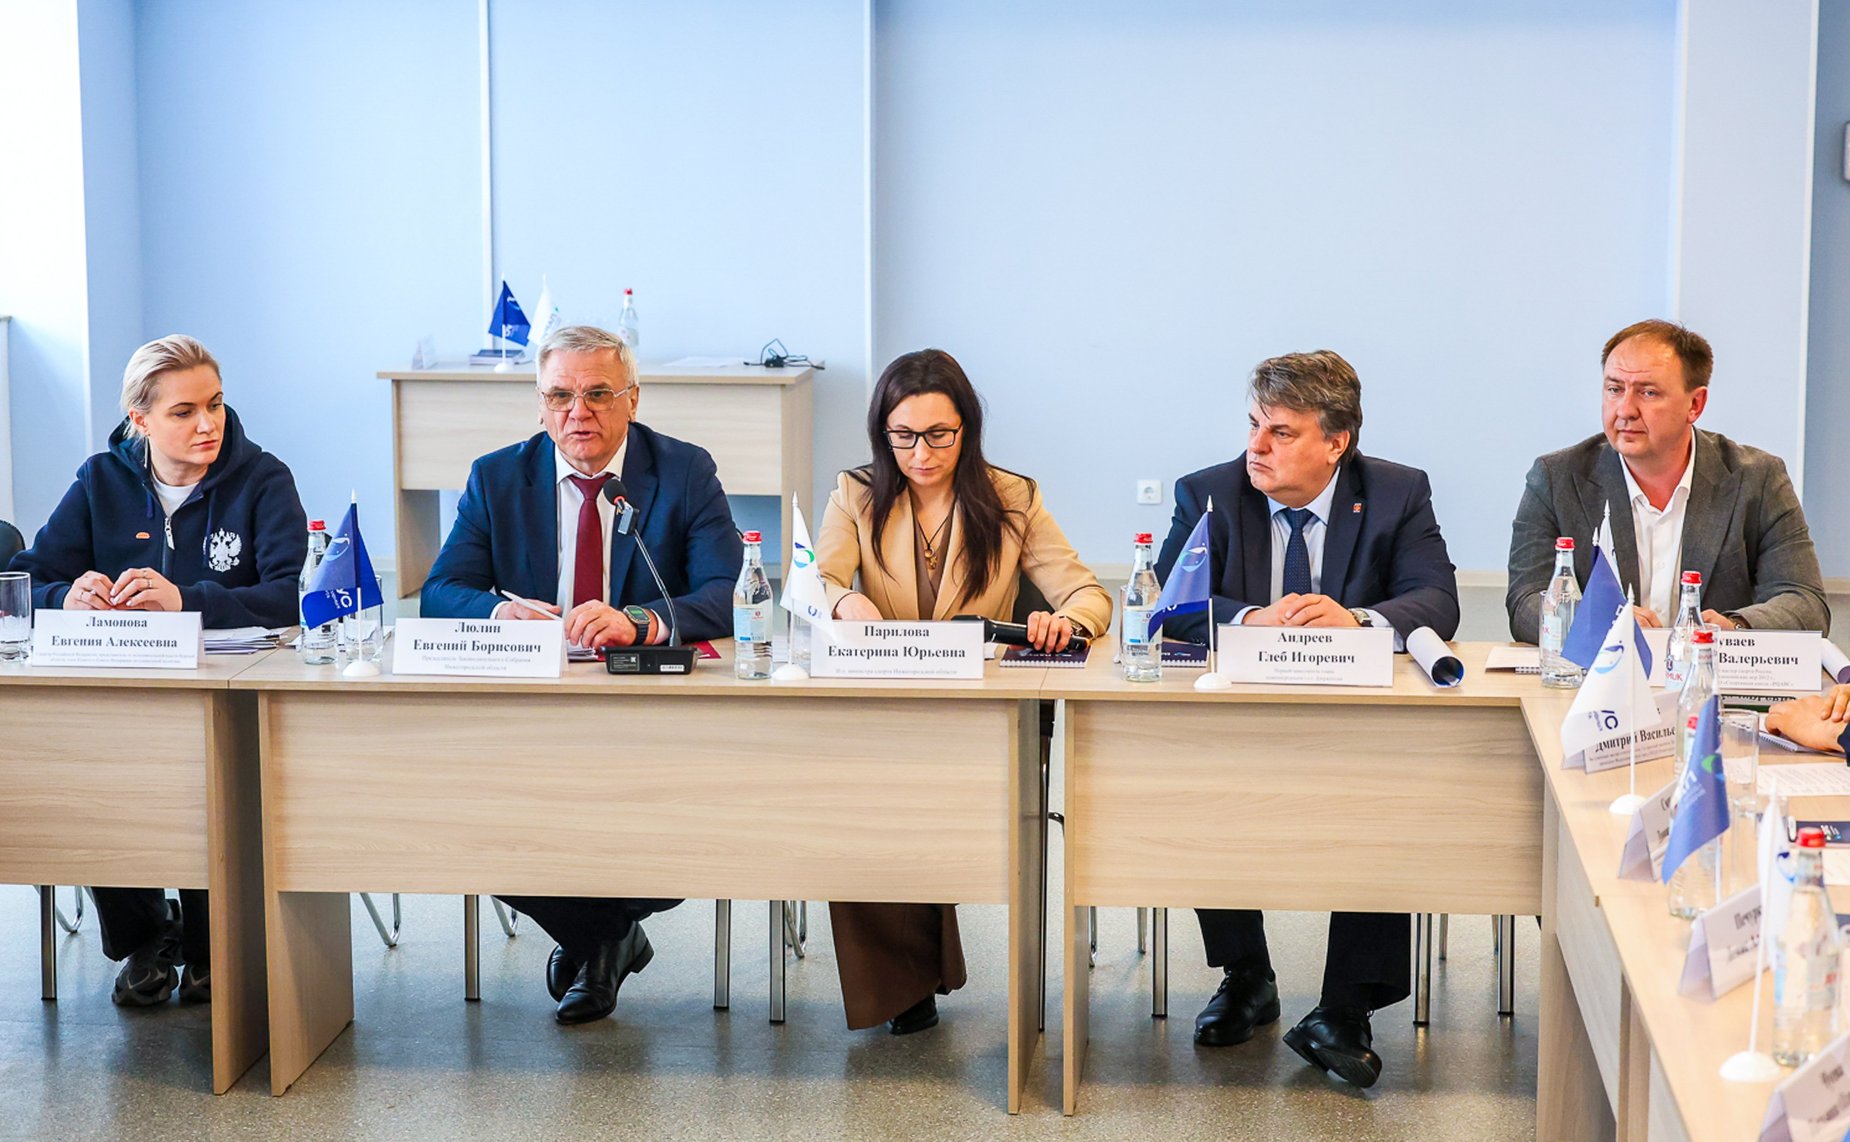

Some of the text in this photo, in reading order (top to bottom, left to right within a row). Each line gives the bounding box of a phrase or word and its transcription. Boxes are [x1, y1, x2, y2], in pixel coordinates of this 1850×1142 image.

[86, 616, 148, 628] Ламонова
[454, 621, 501, 634] Люлин
[864, 625, 930, 640] Парилова
[1277, 632, 1333, 645] Андреев
[51, 635, 178, 648] Евгения Алексеевна
[413, 638, 542, 655] Евгений Борисович
[828, 645, 966, 660] Екатерина Юрьевна
[1258, 651, 1355, 666] Глеб Игоревич
[1719, 652, 1799, 667] Валерьевич
